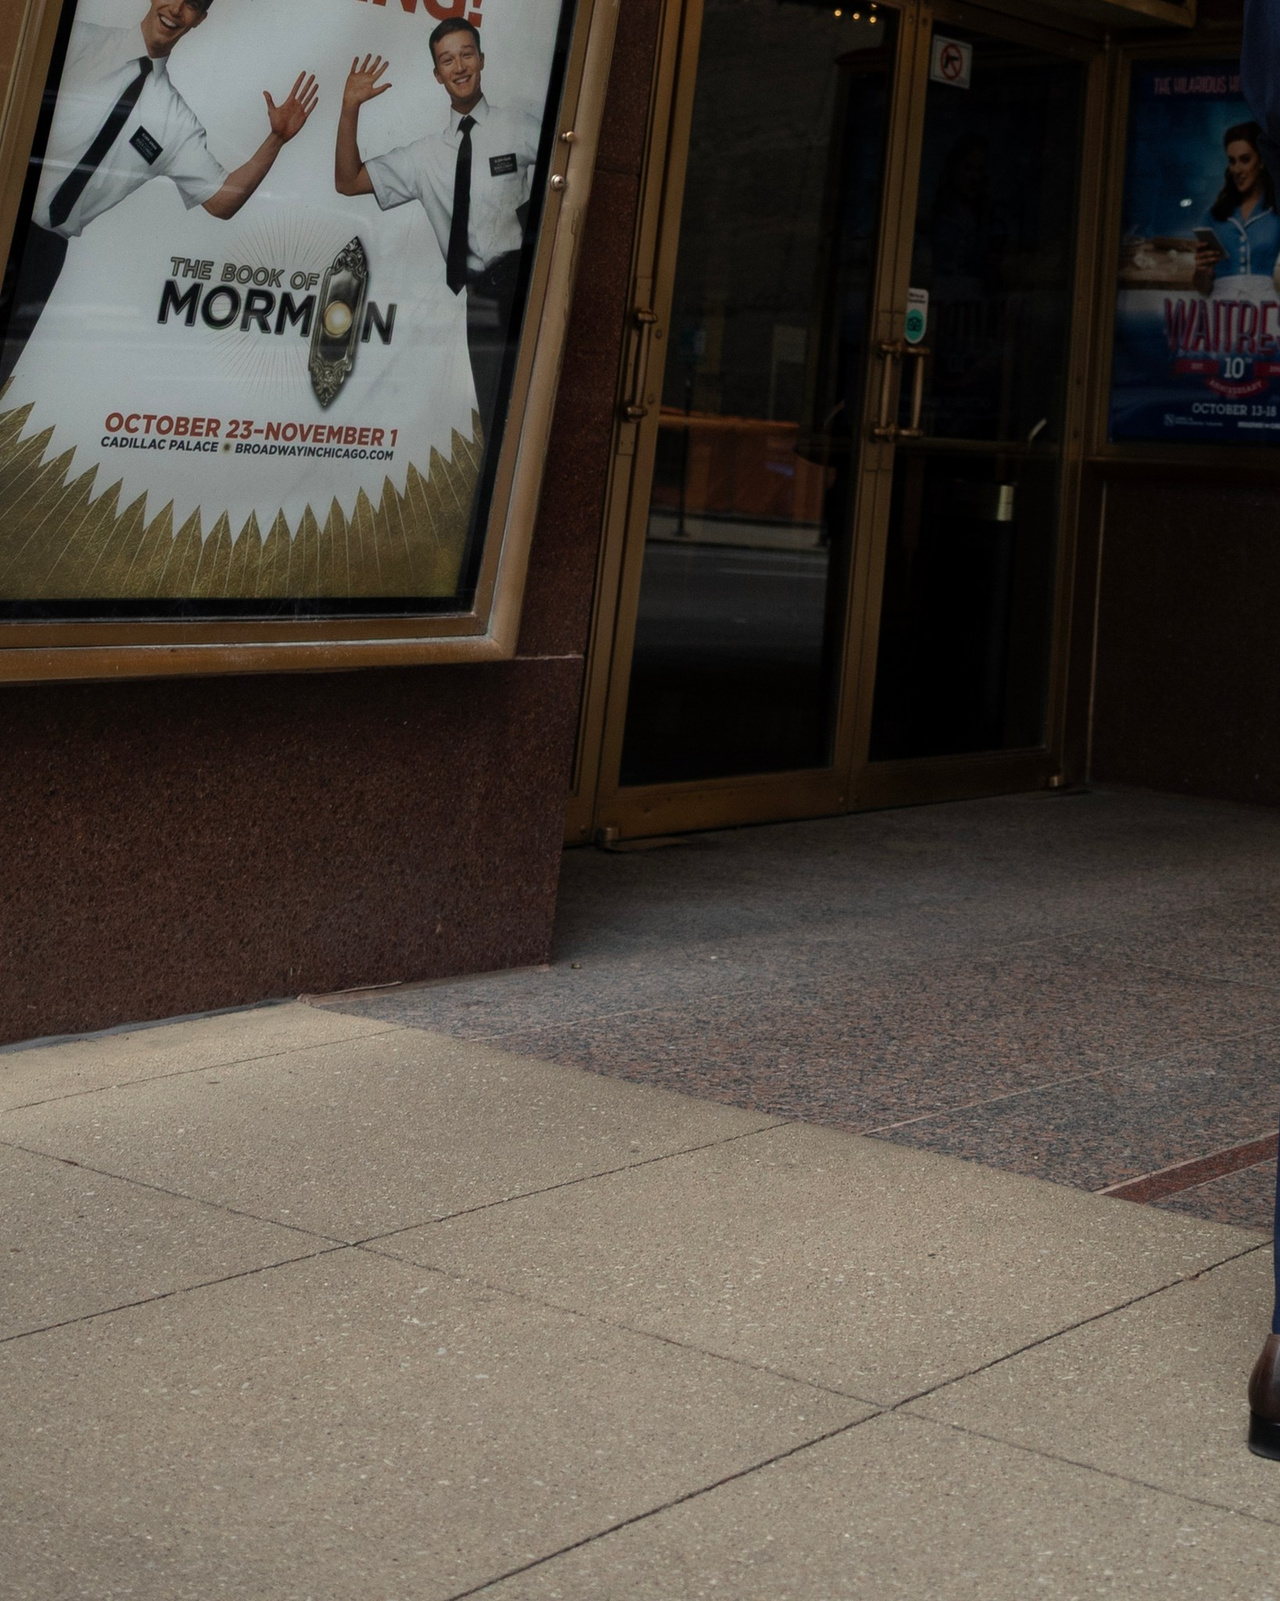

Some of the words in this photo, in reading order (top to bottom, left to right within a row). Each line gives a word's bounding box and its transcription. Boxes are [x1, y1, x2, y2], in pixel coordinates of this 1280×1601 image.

[171, 257, 214, 280] THE
[221, 263, 285, 288] BOOK
[290, 271, 320, 291] OF
[1191, 402, 1248, 416] OCTOBER
[105, 412, 221, 438] OCTOBER
[390, 428, 398, 447] 1
[100, 436, 166, 451] CADILLAC
[169, 440, 219, 453] PALACE
[235, 443, 394, 461] BROADWAYINCHICAGO.COM
